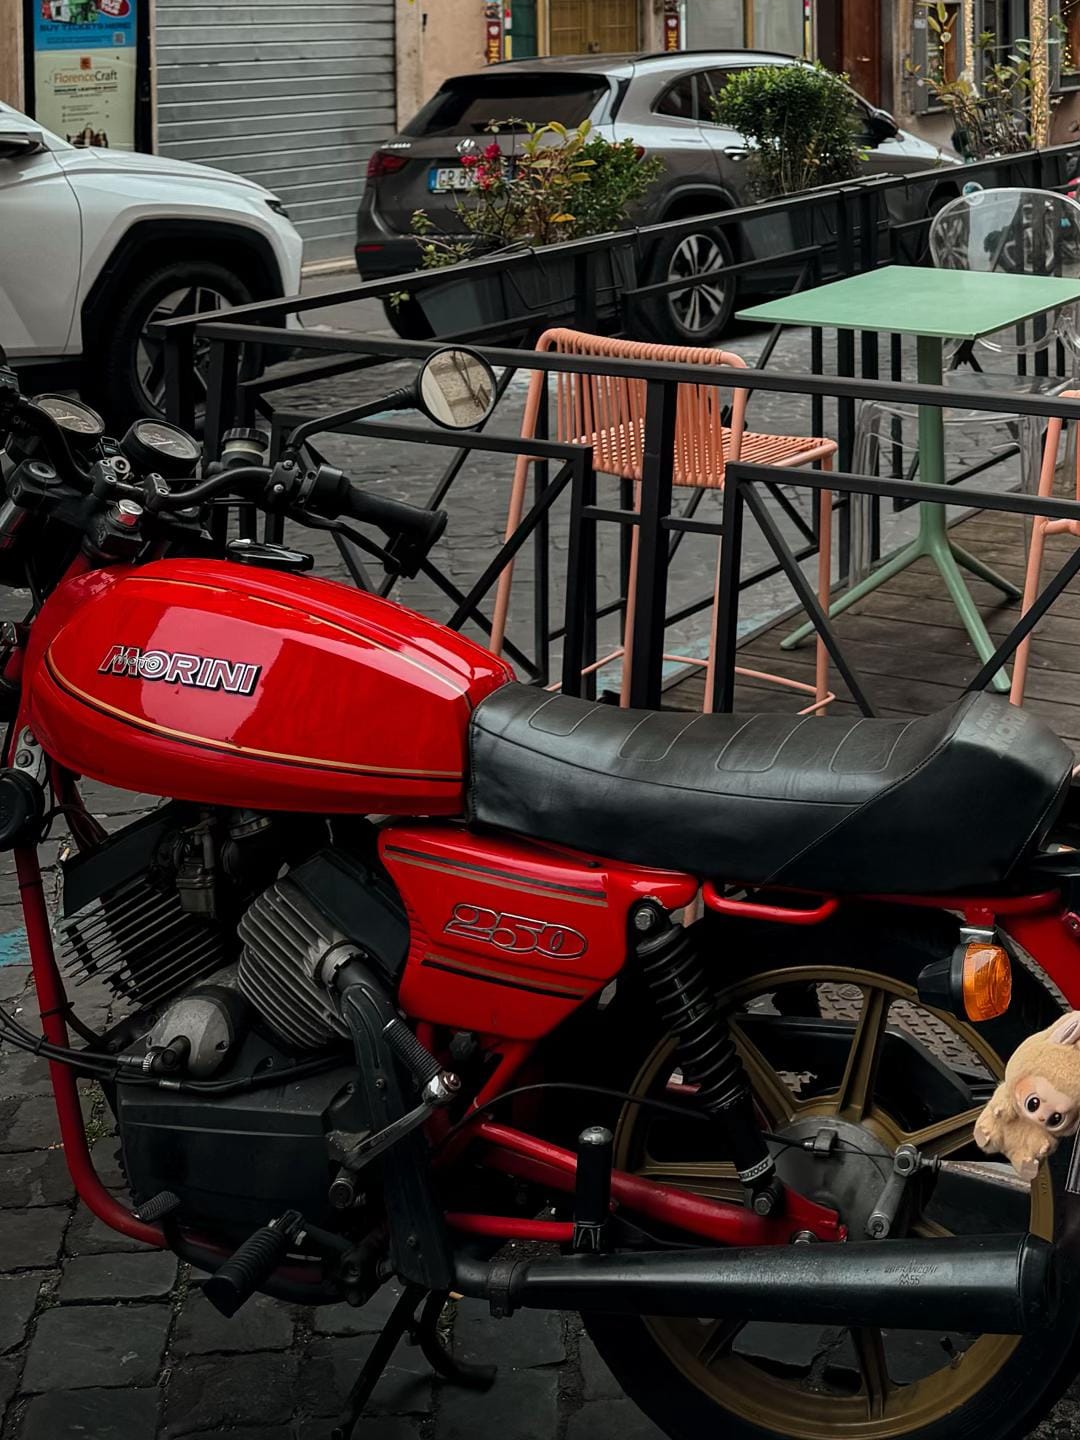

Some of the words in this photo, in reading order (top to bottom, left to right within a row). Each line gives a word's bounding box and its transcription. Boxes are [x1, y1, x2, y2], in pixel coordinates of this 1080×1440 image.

[54, 69, 118, 84] FlorenceCraft
[98, 645, 262, 696] MORINI
[443, 902, 588, 960] 250
